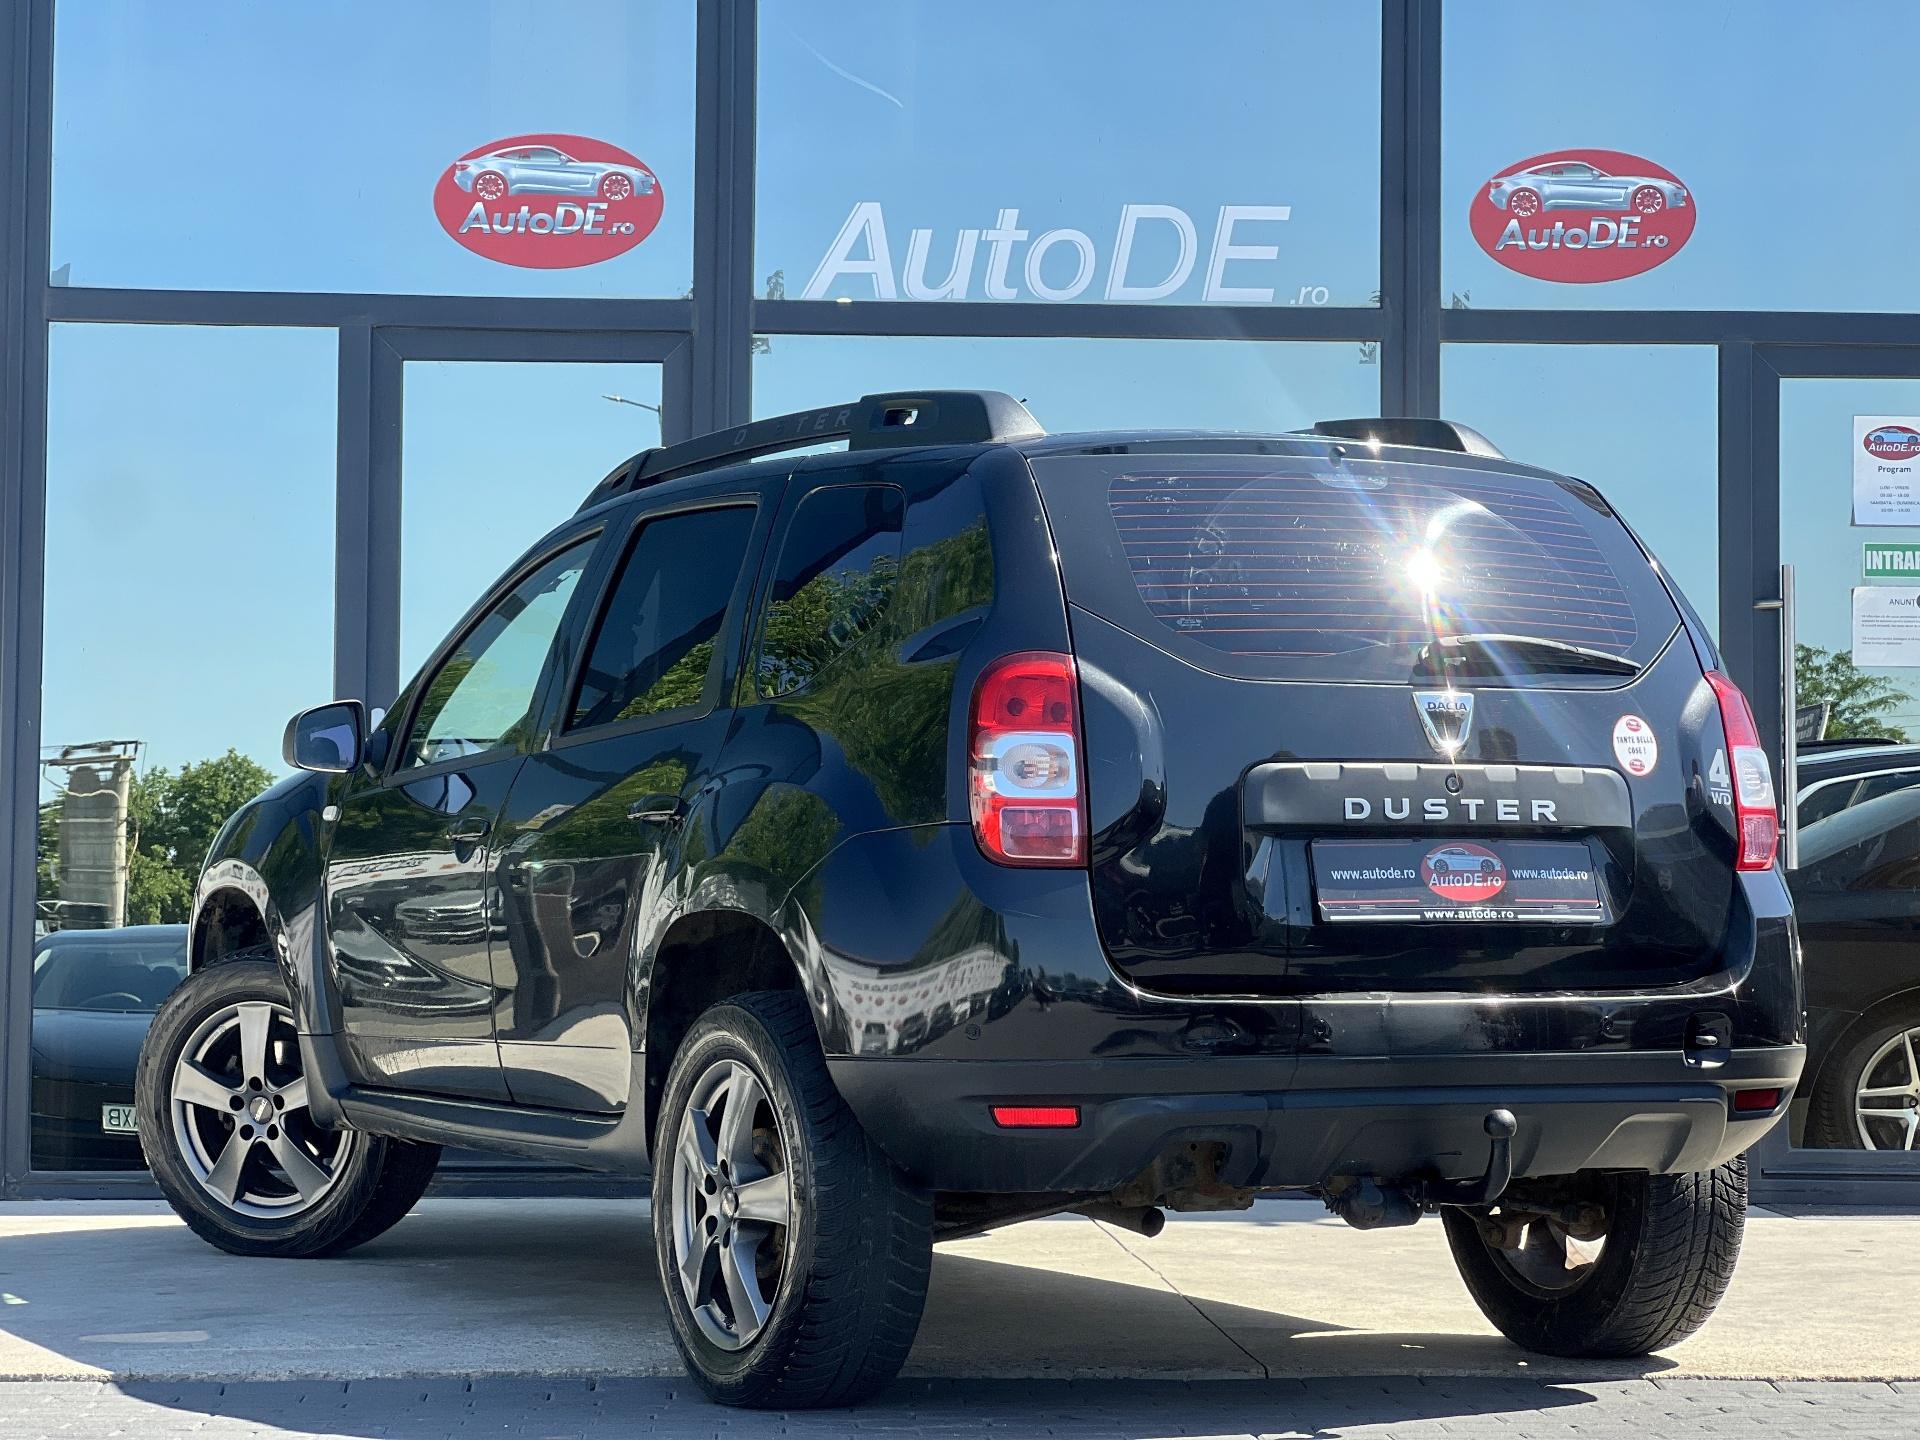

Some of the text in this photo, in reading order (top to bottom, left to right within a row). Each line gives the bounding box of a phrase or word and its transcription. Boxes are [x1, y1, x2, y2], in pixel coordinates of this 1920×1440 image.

[733, 408, 851, 446] DTER
[1877, 466, 1911, 474] Program
[1427, 702, 1468, 711] DACIA
[1708, 748, 1730, 788] 4
[1711, 791, 1731, 806] WD
[1343, 796, 1559, 822] DUSTER
[1331, 868, 1416, 881] www.autode.ro
[1429, 872, 1502, 888] AutoDE.ro
[1512, 868, 1588, 880] www.autode.ro
[1424, 908, 1515, 920] www.autode.ro
